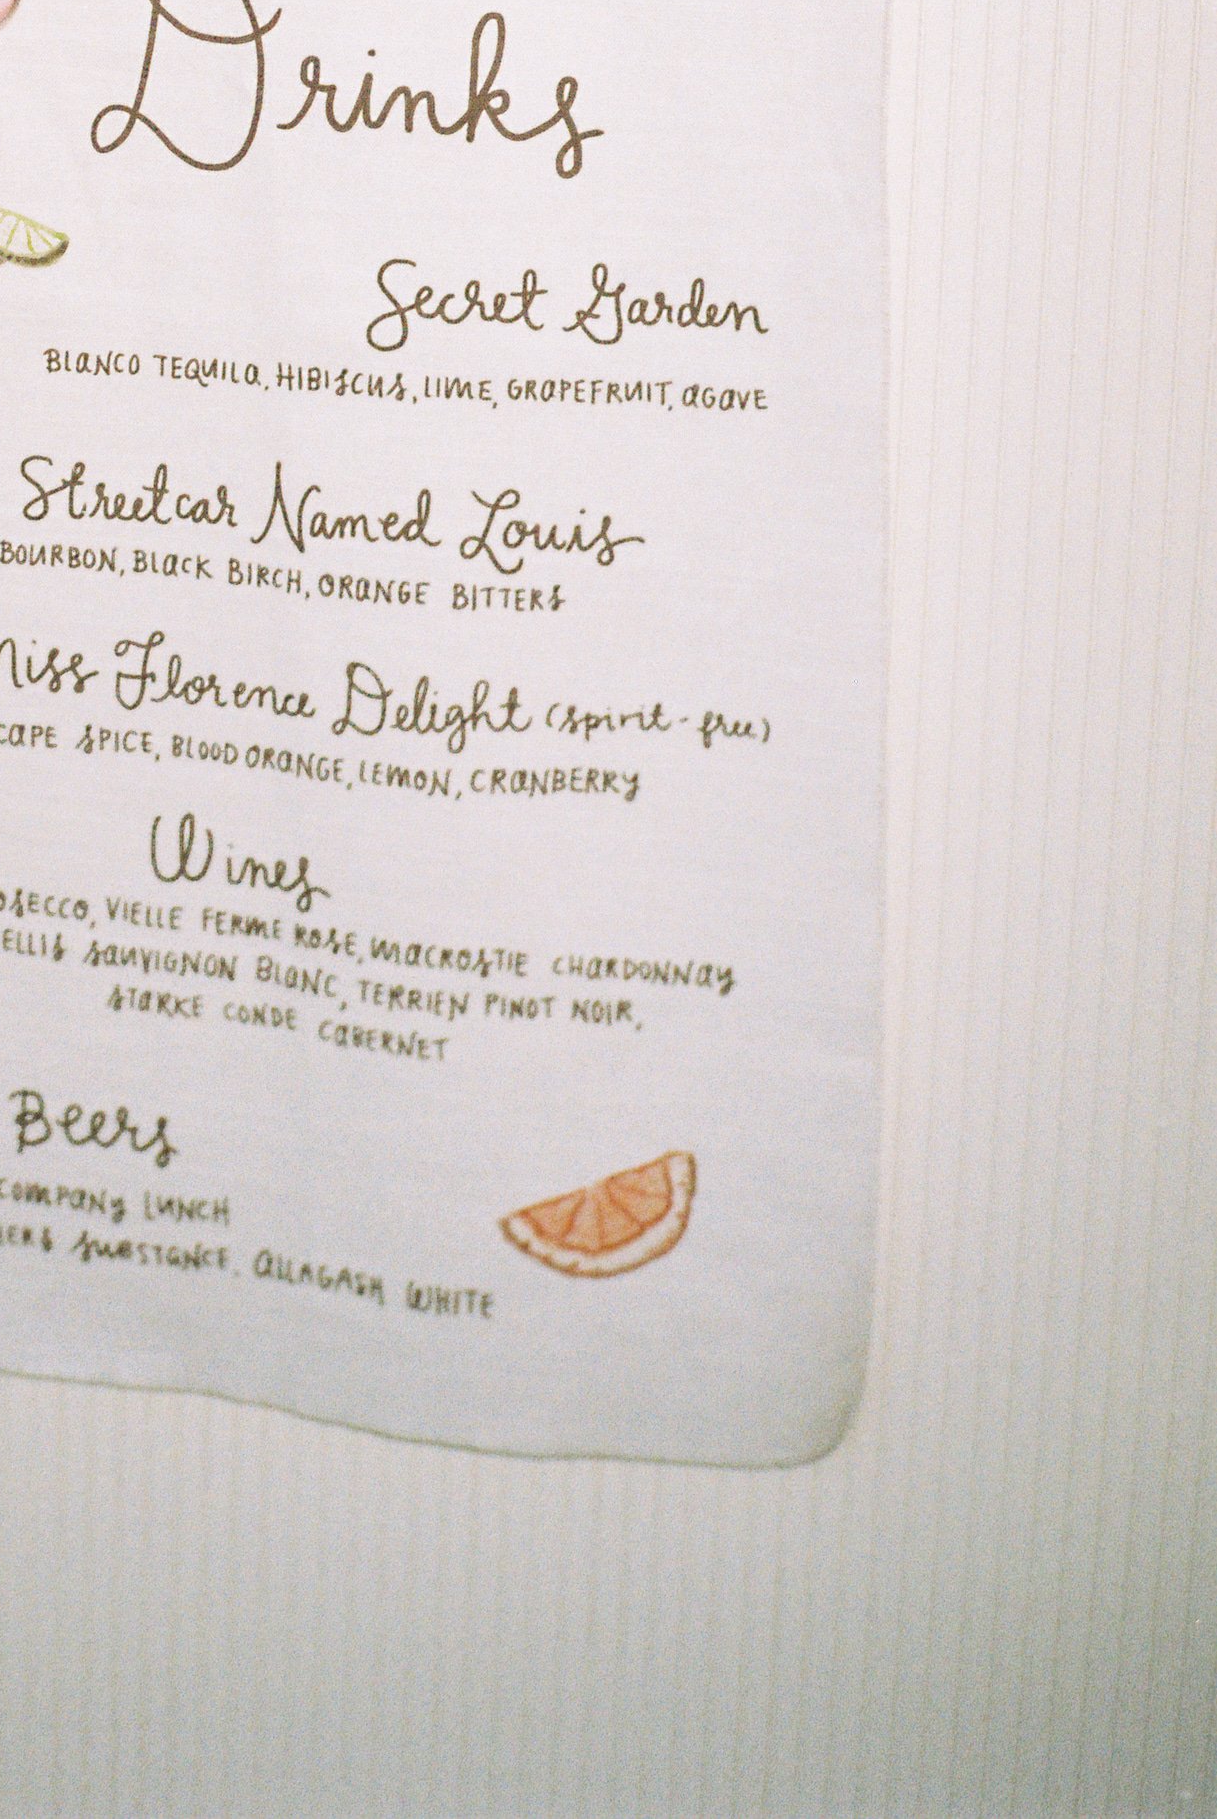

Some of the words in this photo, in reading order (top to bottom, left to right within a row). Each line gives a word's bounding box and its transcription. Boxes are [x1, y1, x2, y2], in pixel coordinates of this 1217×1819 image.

[365, 257, 548, 353] Secret
[562, 262, 769, 346] Garden
[43, 347, 141, 376] BLANCO
[153, 354, 269, 391] TEQUILA,
[276, 362, 418, 404] HIBISCUS,
[423, 376, 498, 409] LIME,
[506, 378, 673, 411] GRAPEFRUIT,
[681, 383, 768, 412] AGAVE
[19, 454, 237, 528] Streetcar
[250, 460, 441, 554] Named
[459, 488, 646, 576] Louis
[132, 549, 212, 579] BLACK
[227, 557, 310, 599] BIRCH,
[318, 573, 429, 605] ORANGE
[451, 583, 565, 612] BITTERS
[114, 630, 316, 718] Florence
[331, 661, 532, 754] Delight
[76, 724, 160, 762] SPICE,
[171, 734, 239, 765] BLOOD
[245, 744, 352, 790] ORANGE,
[359, 762, 462, 800] LEMON,
[470, 767, 640, 803] CRANBERRY
[150, 812, 331, 913] Wines
[2, 928, 66, 962] ELLIS
[83, 940, 236, 981] SAUVIGNON
[256, 956, 347, 1011] BLANC,
[360, 980, 469, 1021] TERRIEN
[485, 993, 554, 1020] PINOT
[106, 898, 181, 930] VIELLE
[202, 908, 280, 939] FERME
[293, 923, 364, 964] ROSE,
[370, 938, 527, 979] MACROSTIE
[552, 957, 736, 997] CHARDONNAY
[107, 985, 200, 1018] STARKE
[224, 1004, 295, 1031] CONDE
[318, 1021, 447, 1060] CABERNET
[9, 1088, 178, 1169] Beers
[145, 1195, 230, 1225] LUNCH
[406, 1281, 493, 1319] WHITE
